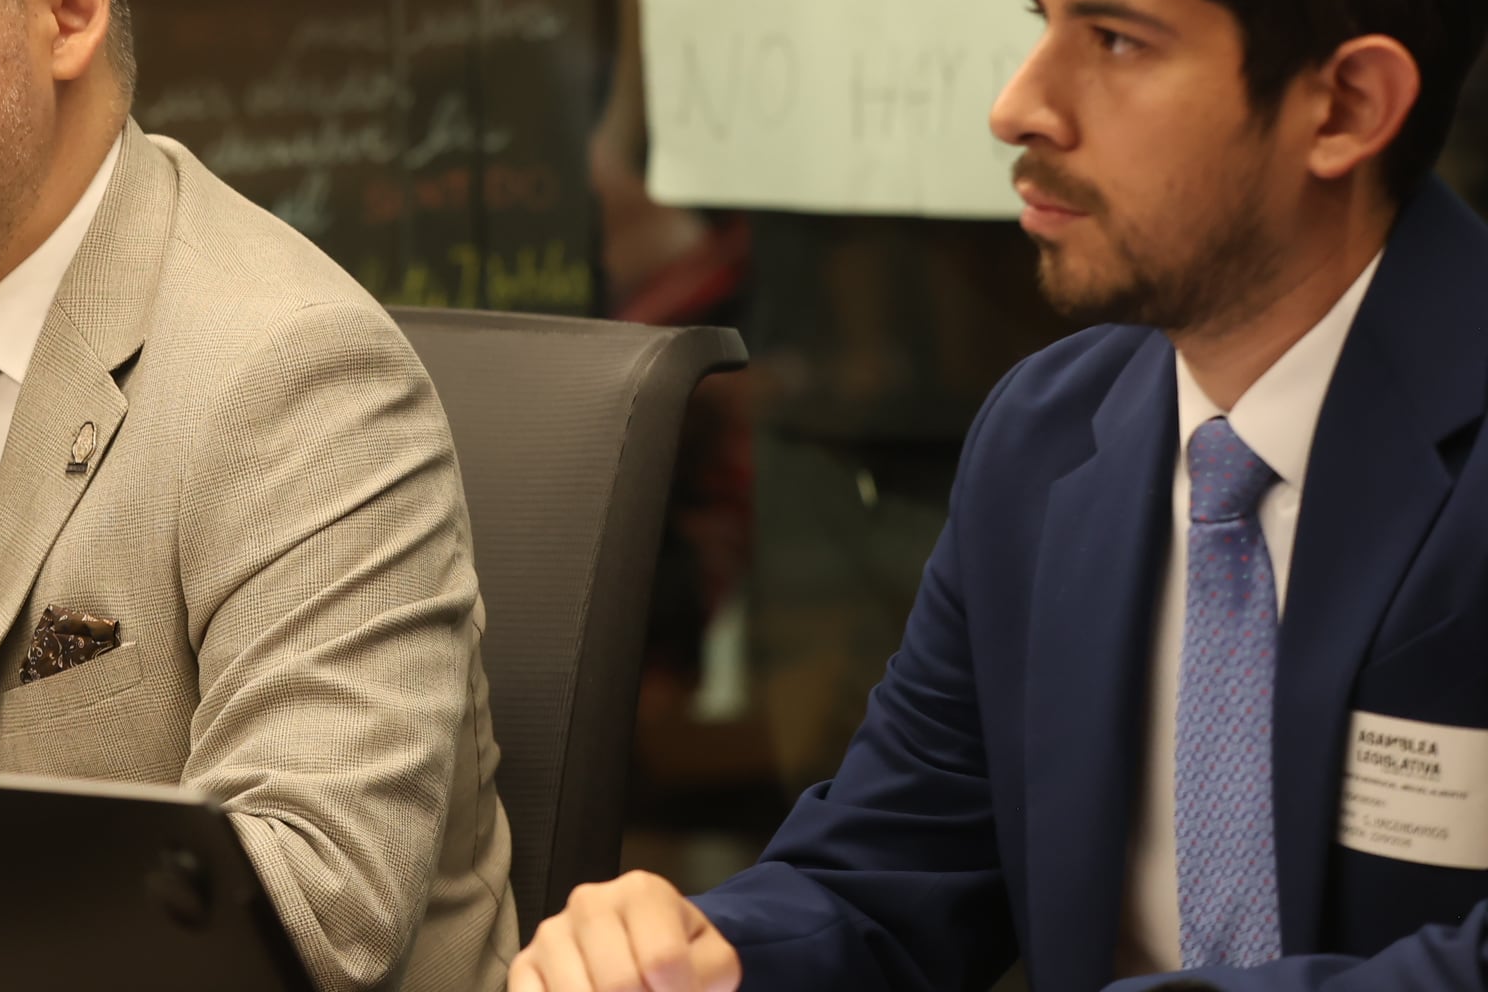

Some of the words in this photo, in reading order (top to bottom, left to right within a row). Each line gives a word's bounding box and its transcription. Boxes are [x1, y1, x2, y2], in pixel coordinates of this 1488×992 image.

[677, 35, 797, 137] NO
[853, 49, 963, 139] HAY
[1357, 730, 1439, 757] ASAMBLEA
[1356, 749, 1443, 776] LEGISLATIVA
